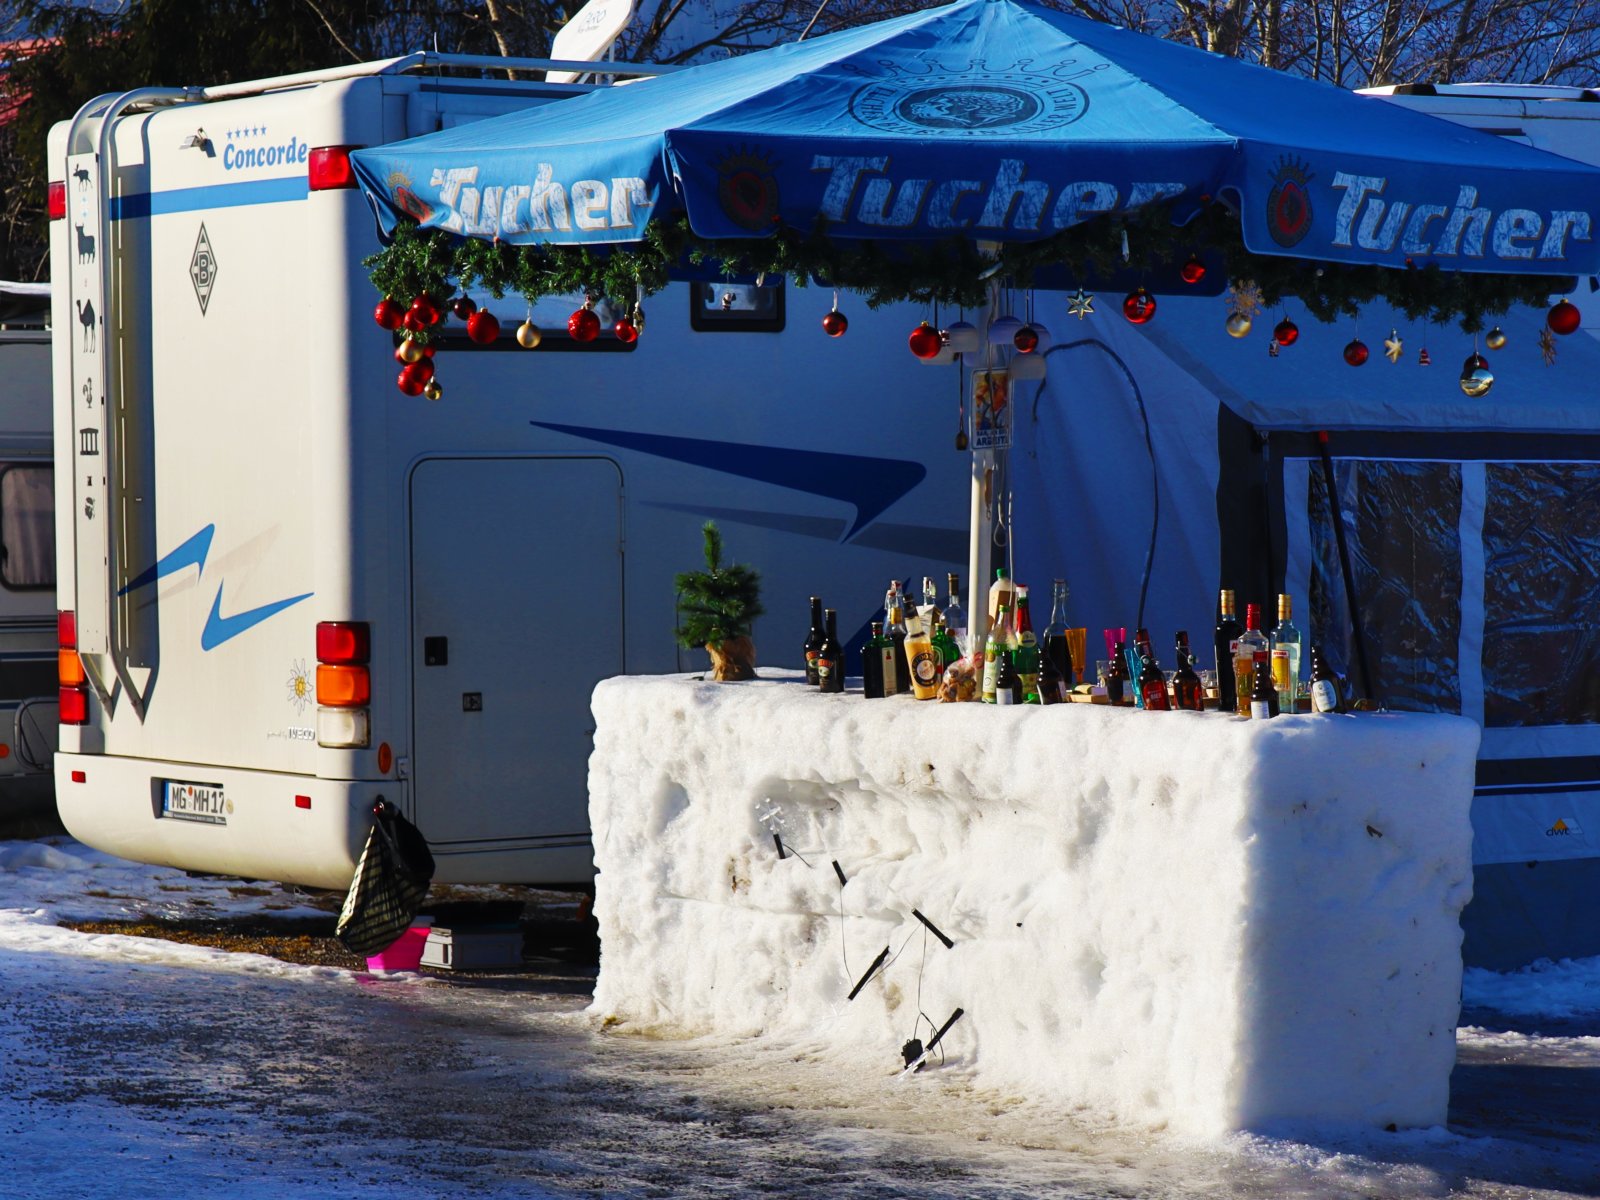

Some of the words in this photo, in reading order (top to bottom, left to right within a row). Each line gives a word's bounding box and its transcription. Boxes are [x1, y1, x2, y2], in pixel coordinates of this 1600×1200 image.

[1046, 88, 1077, 112] WELT
[223, 136, 308, 171] Concorde
[429, 162, 656, 235] Tucher
[810, 154, 1187, 231] Tucher
[1331, 171, 1593, 261] Tucher
[172, 786, 187, 810] MG
